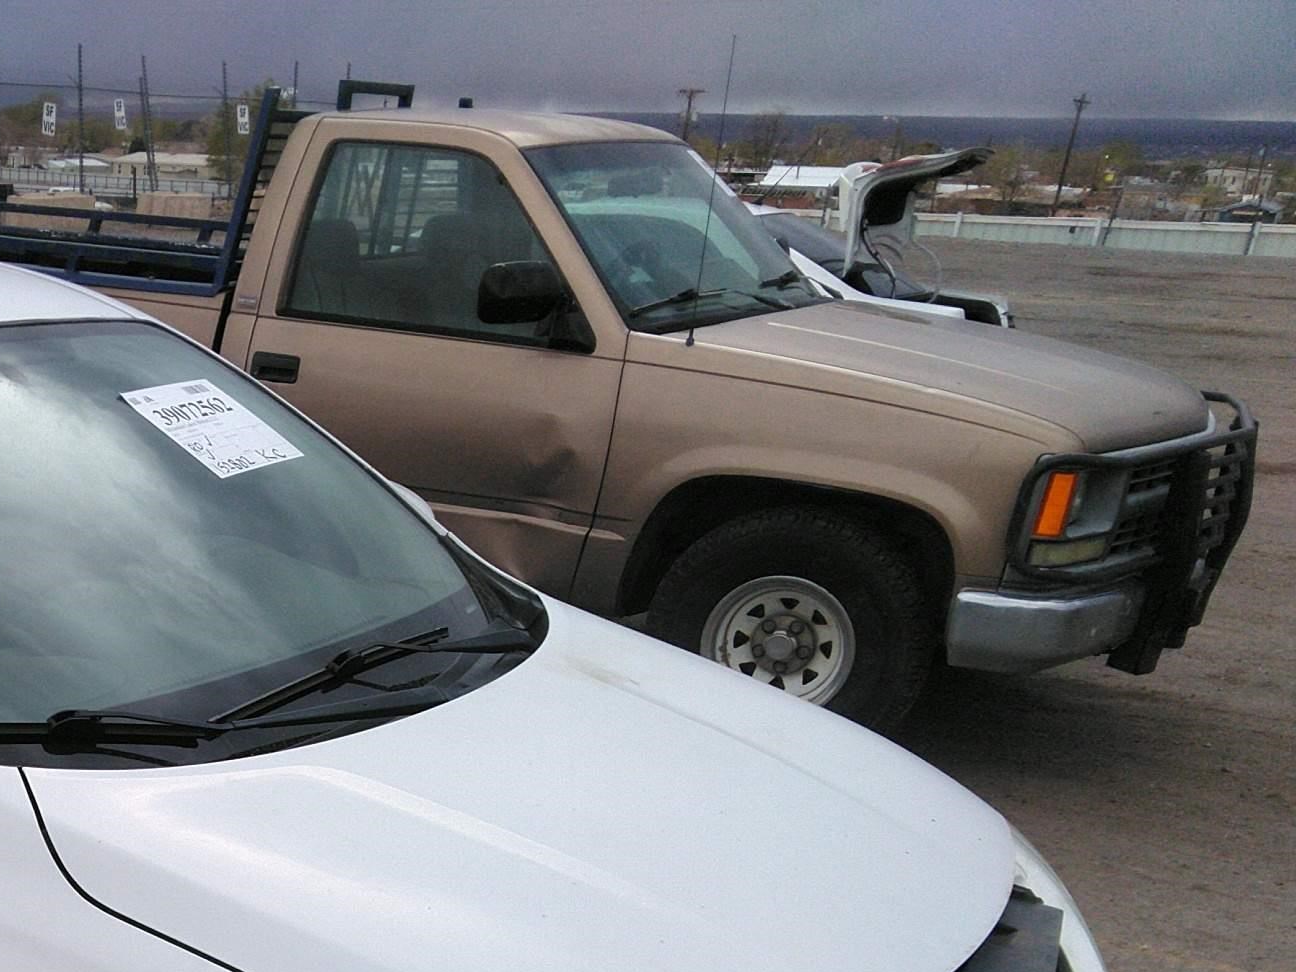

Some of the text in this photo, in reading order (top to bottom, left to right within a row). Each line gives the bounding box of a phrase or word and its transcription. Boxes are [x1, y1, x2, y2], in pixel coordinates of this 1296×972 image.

[45, 104, 54, 117] SF
[43, 120, 54, 133] VIC
[152, 396, 233, 426] 39072562
